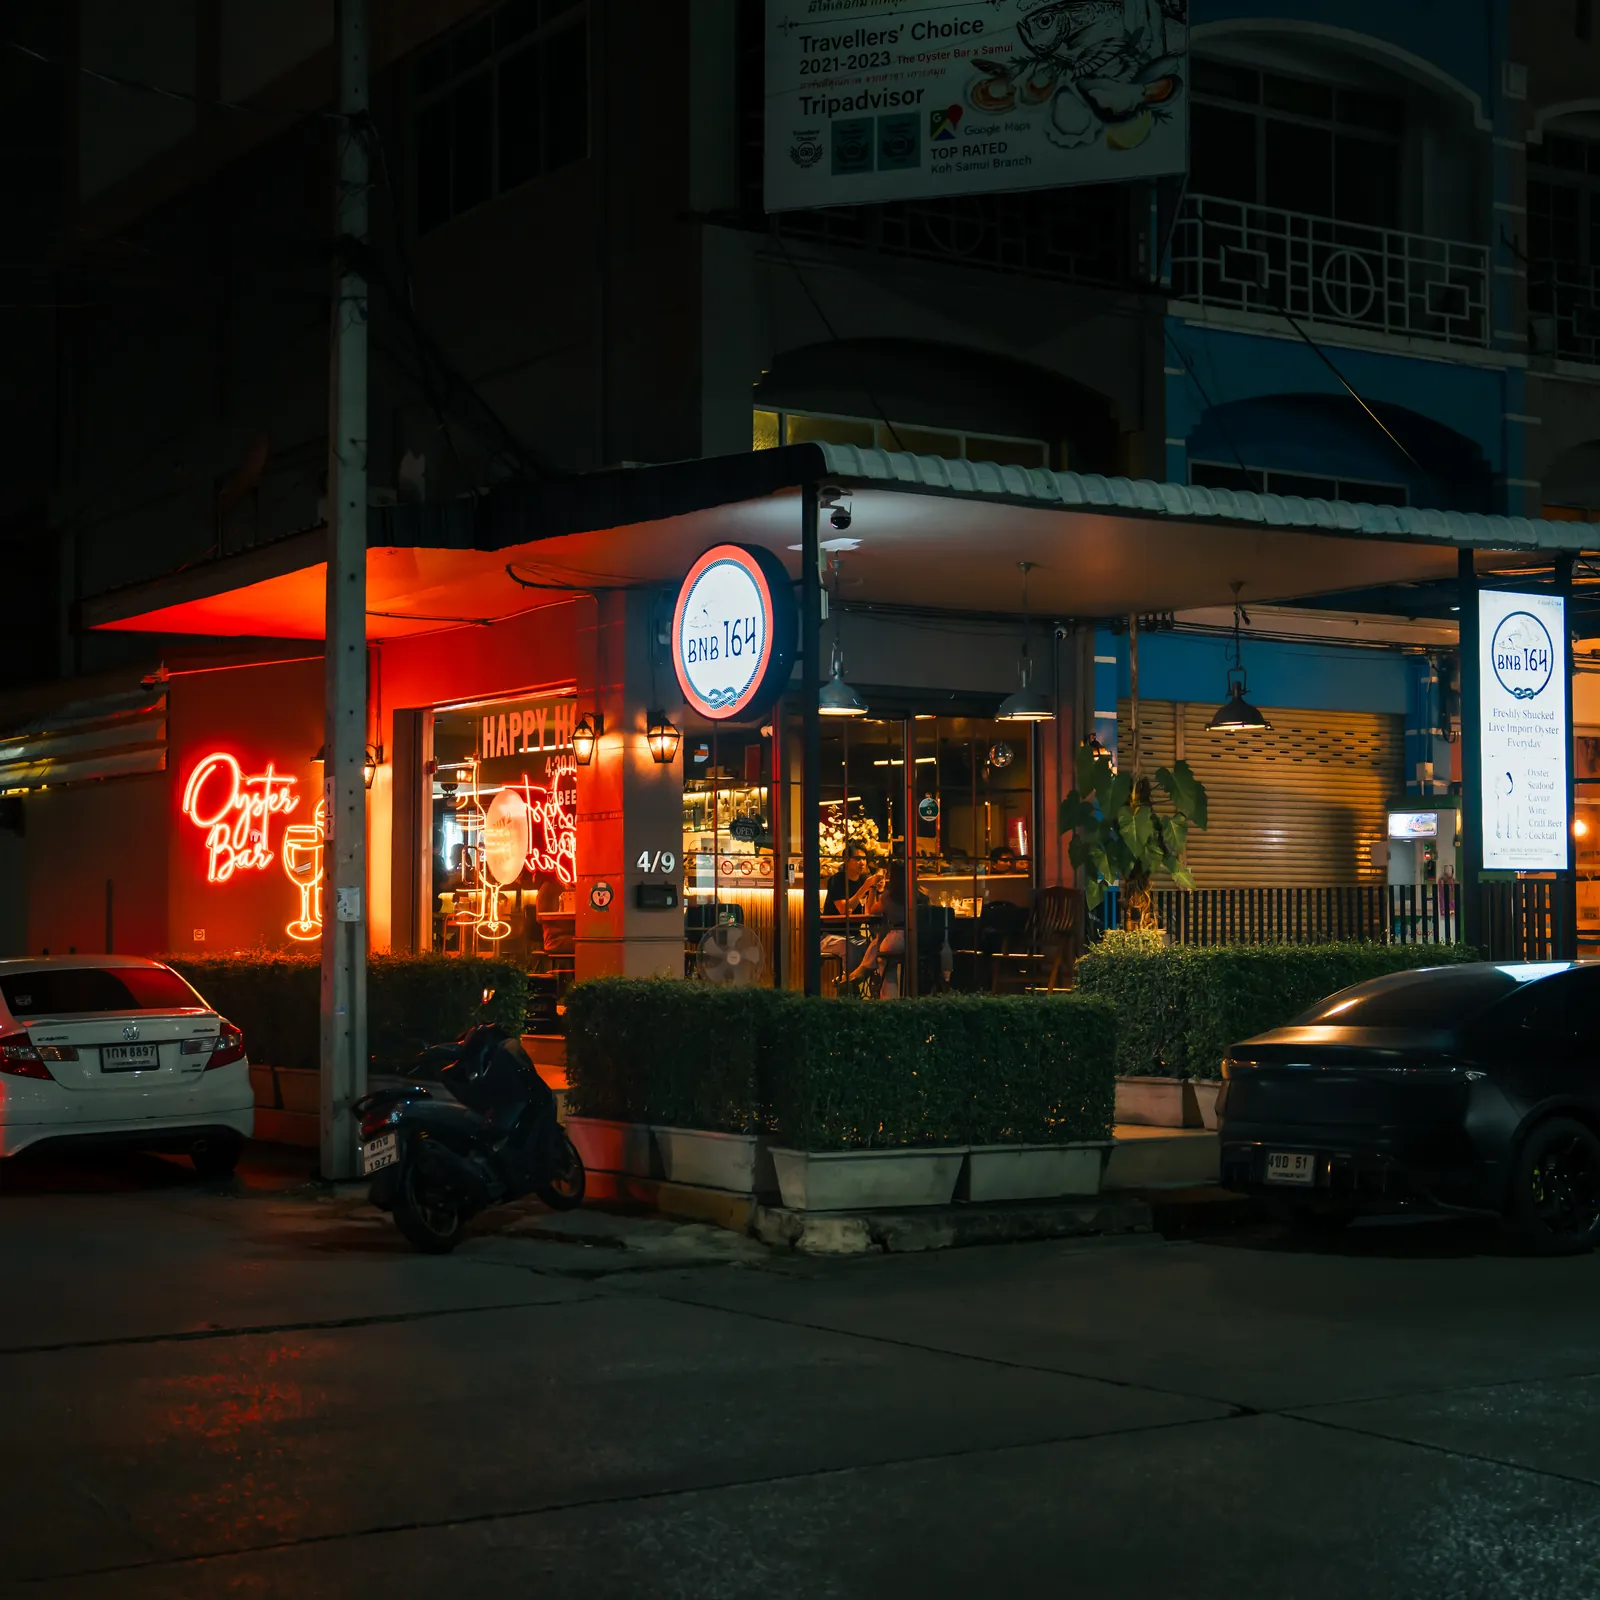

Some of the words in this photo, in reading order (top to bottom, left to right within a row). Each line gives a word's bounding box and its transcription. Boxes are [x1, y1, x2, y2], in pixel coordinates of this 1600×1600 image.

[800, 23, 904, 53] Travellers'
[911, 18, 984, 41] Choice
[800, 51, 891, 75] 2021-2023
[897, 55, 915, 65] The
[917, 52, 950, 65] Oyster
[954, 48, 970, 58] Bar
[981, 43, 1013, 55] Samui
[800, 86, 925, 118] Tripadvisor
[964, 123, 1000, 138] Google
[1005, 121, 1031, 134] Maps
[930, 146, 958, 160] TOP
[962, 142, 1008, 157] RATED
[931, 162, 952, 174] Koh
[956, 160, 989, 172] Samui
[993, 155, 1032, 169] Branch
[688, 636, 719, 663] BNB
[723, 616, 757, 658] 164
[1497, 654, 1521, 671] BNB
[1523, 648, 1548, 672] 164
[1493, 708, 1521, 721] Freshly
[1523, 709, 1555, 720] Shucked
[482, 707, 548, 759] HAPPY
[1488, 722, 1505, 732] Live
[1507, 723, 1533, 735] Import
[1535, 725, 1560, 737] Oyster
[1507, 738, 1542, 749] Everyday
[1527, 768, 1550, 780] Oyster
[1528, 781, 1554, 790] Seafood
[183, 751, 300, 851] Oyster
[1528, 806, 1547, 815] Wine
[735, 825, 755, 836] OPEN
[1528, 819, 1547, 828] Craft
[1548, 819, 1563, 828] Beer
[1528, 831, 1557, 840] Cocktail
[206, 823, 275, 882] Bar
[636, 850, 675, 874] 4/9
[370, 1154, 393, 1171] 1977
[1295, 1156, 1307, 1170] 51
